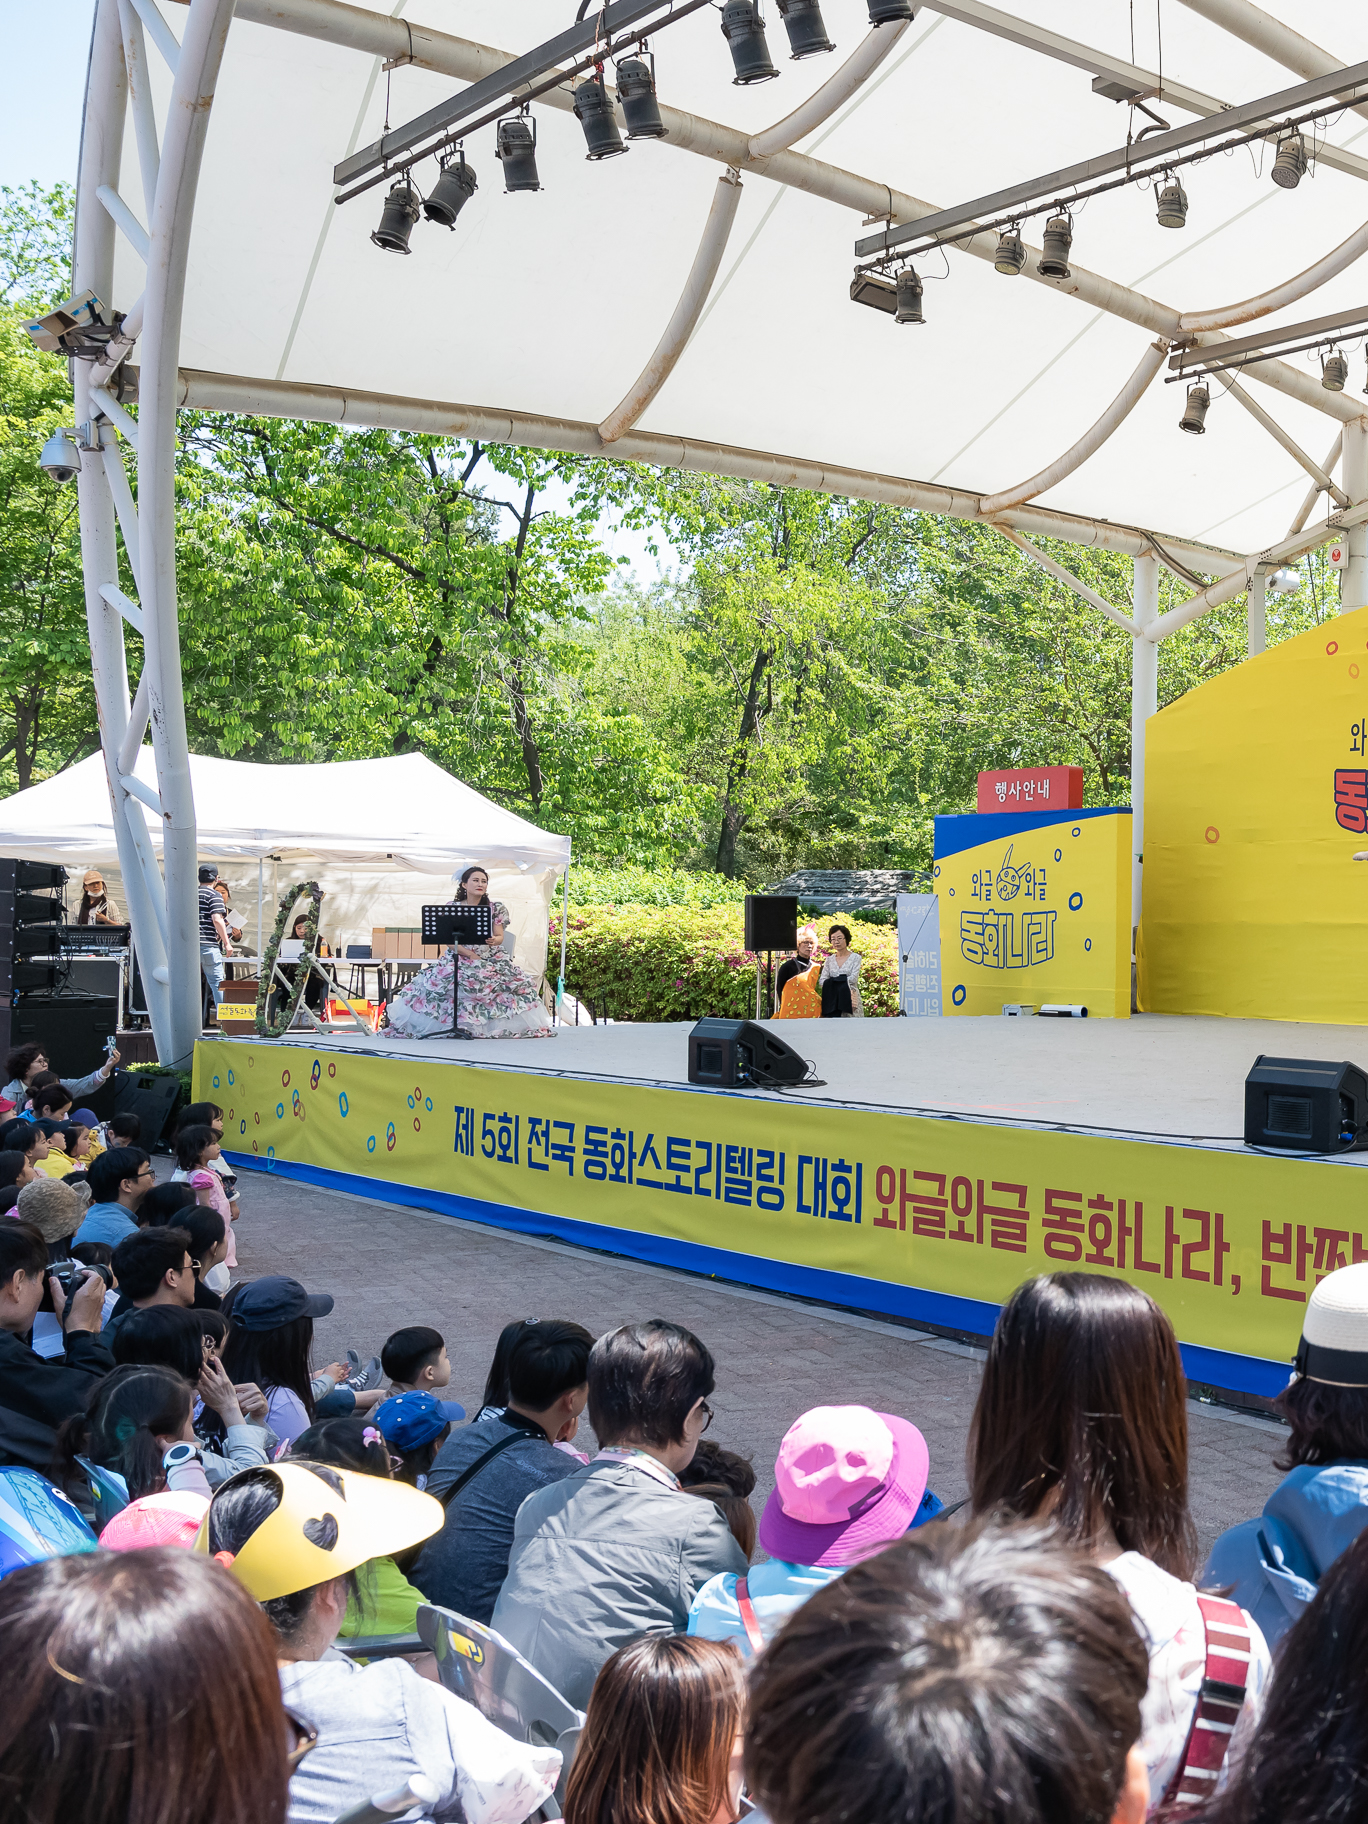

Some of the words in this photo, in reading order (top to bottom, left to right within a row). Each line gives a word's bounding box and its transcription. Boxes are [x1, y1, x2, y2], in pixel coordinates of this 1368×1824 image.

[994, 778, 1050, 803] 행사안내
[971, 869, 993, 901] 와글
[1024, 868, 1047, 901] 와글
[960, 908, 1057, 969] 동화나라
[220, 1006, 257, 1018] 서울동화축
[453, 1104, 475, 1155] 제
[480, 1110, 519, 1166] 5회
[526, 1115, 576, 1177] 전국
[582, 1124, 786, 1212] 동화스토리텔링
[796, 1154, 863, 1224] 대회
[873, 1164, 1030, 1254] 와글와글
[1041, 1187, 1242, 1296] 동화나라,
